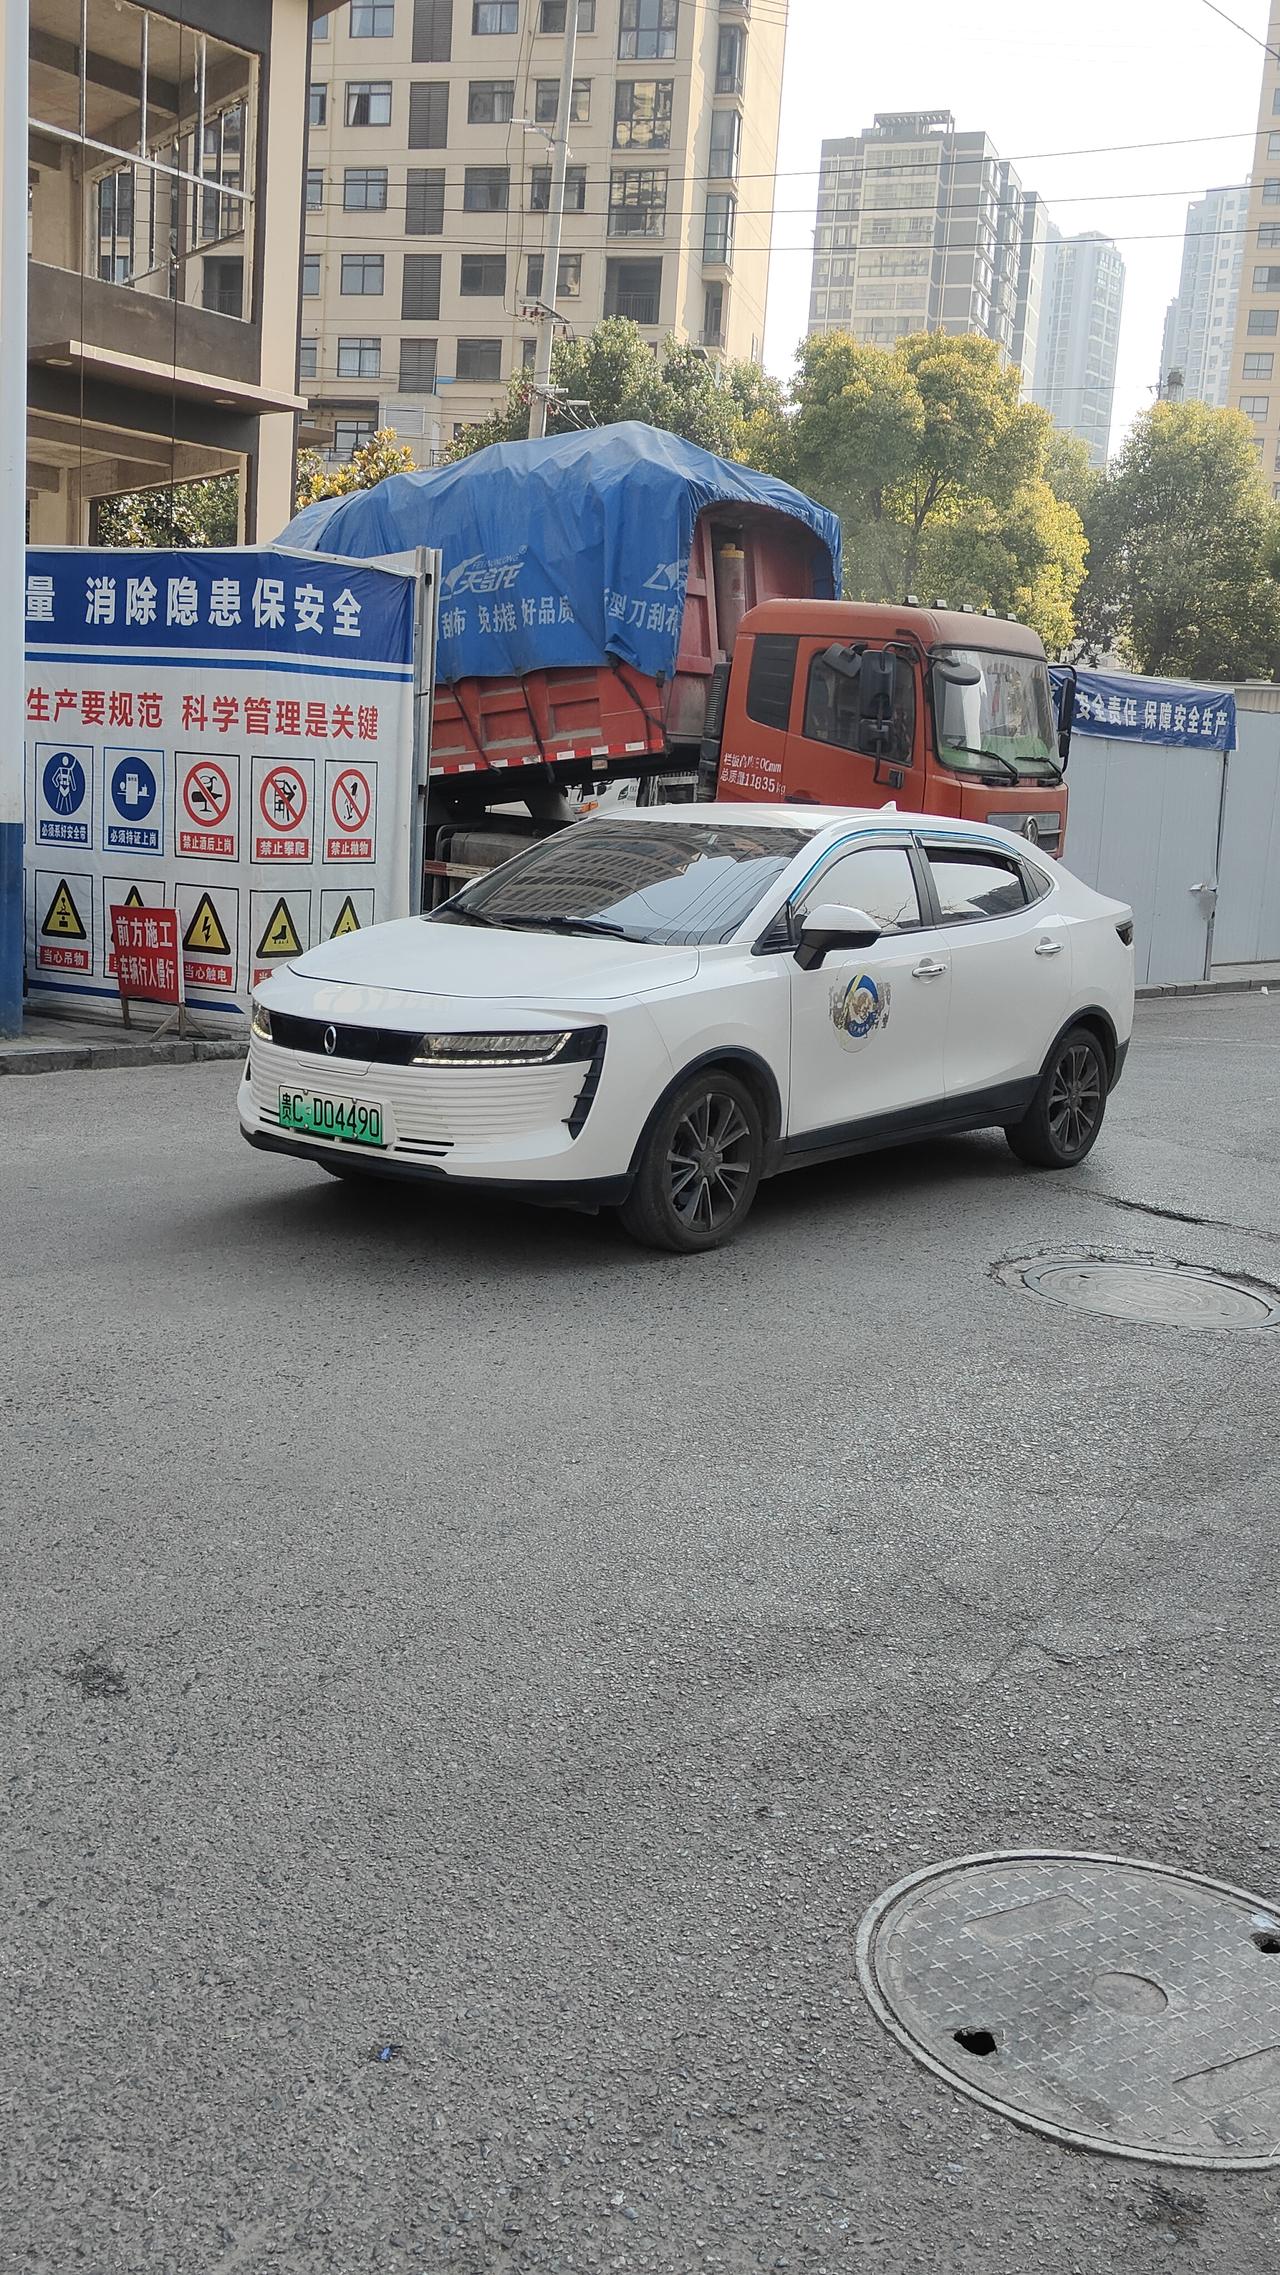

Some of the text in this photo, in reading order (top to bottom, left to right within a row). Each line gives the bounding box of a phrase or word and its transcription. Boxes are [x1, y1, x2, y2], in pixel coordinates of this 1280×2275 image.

[25, 575, 362, 637] 量 消除隐患保安全
[521, 595, 575, 627] 好品质
[604, 588, 679, 636] 型刀刮布
[26, 687, 379, 740] 生产要规范 科学管理是关键
[1144, 700, 1228, 736] 保障安全生产
[41, 823, 87, 840] 必须系好安全带
[110, 829, 157, 847] 必须持证上岗
[182, 834, 233, 853] 禁止酒后上岗
[260, 841, 305, 856] 禁止攀爬
[330, 840, 369, 855] 禁止抛物
[115, 916, 173, 949] 前方施工
[43, 949, 85, 966] 当心吊物
[119, 955, 175, 990] 车辆行人慢行
[184, 965, 228, 983] 当心触电
